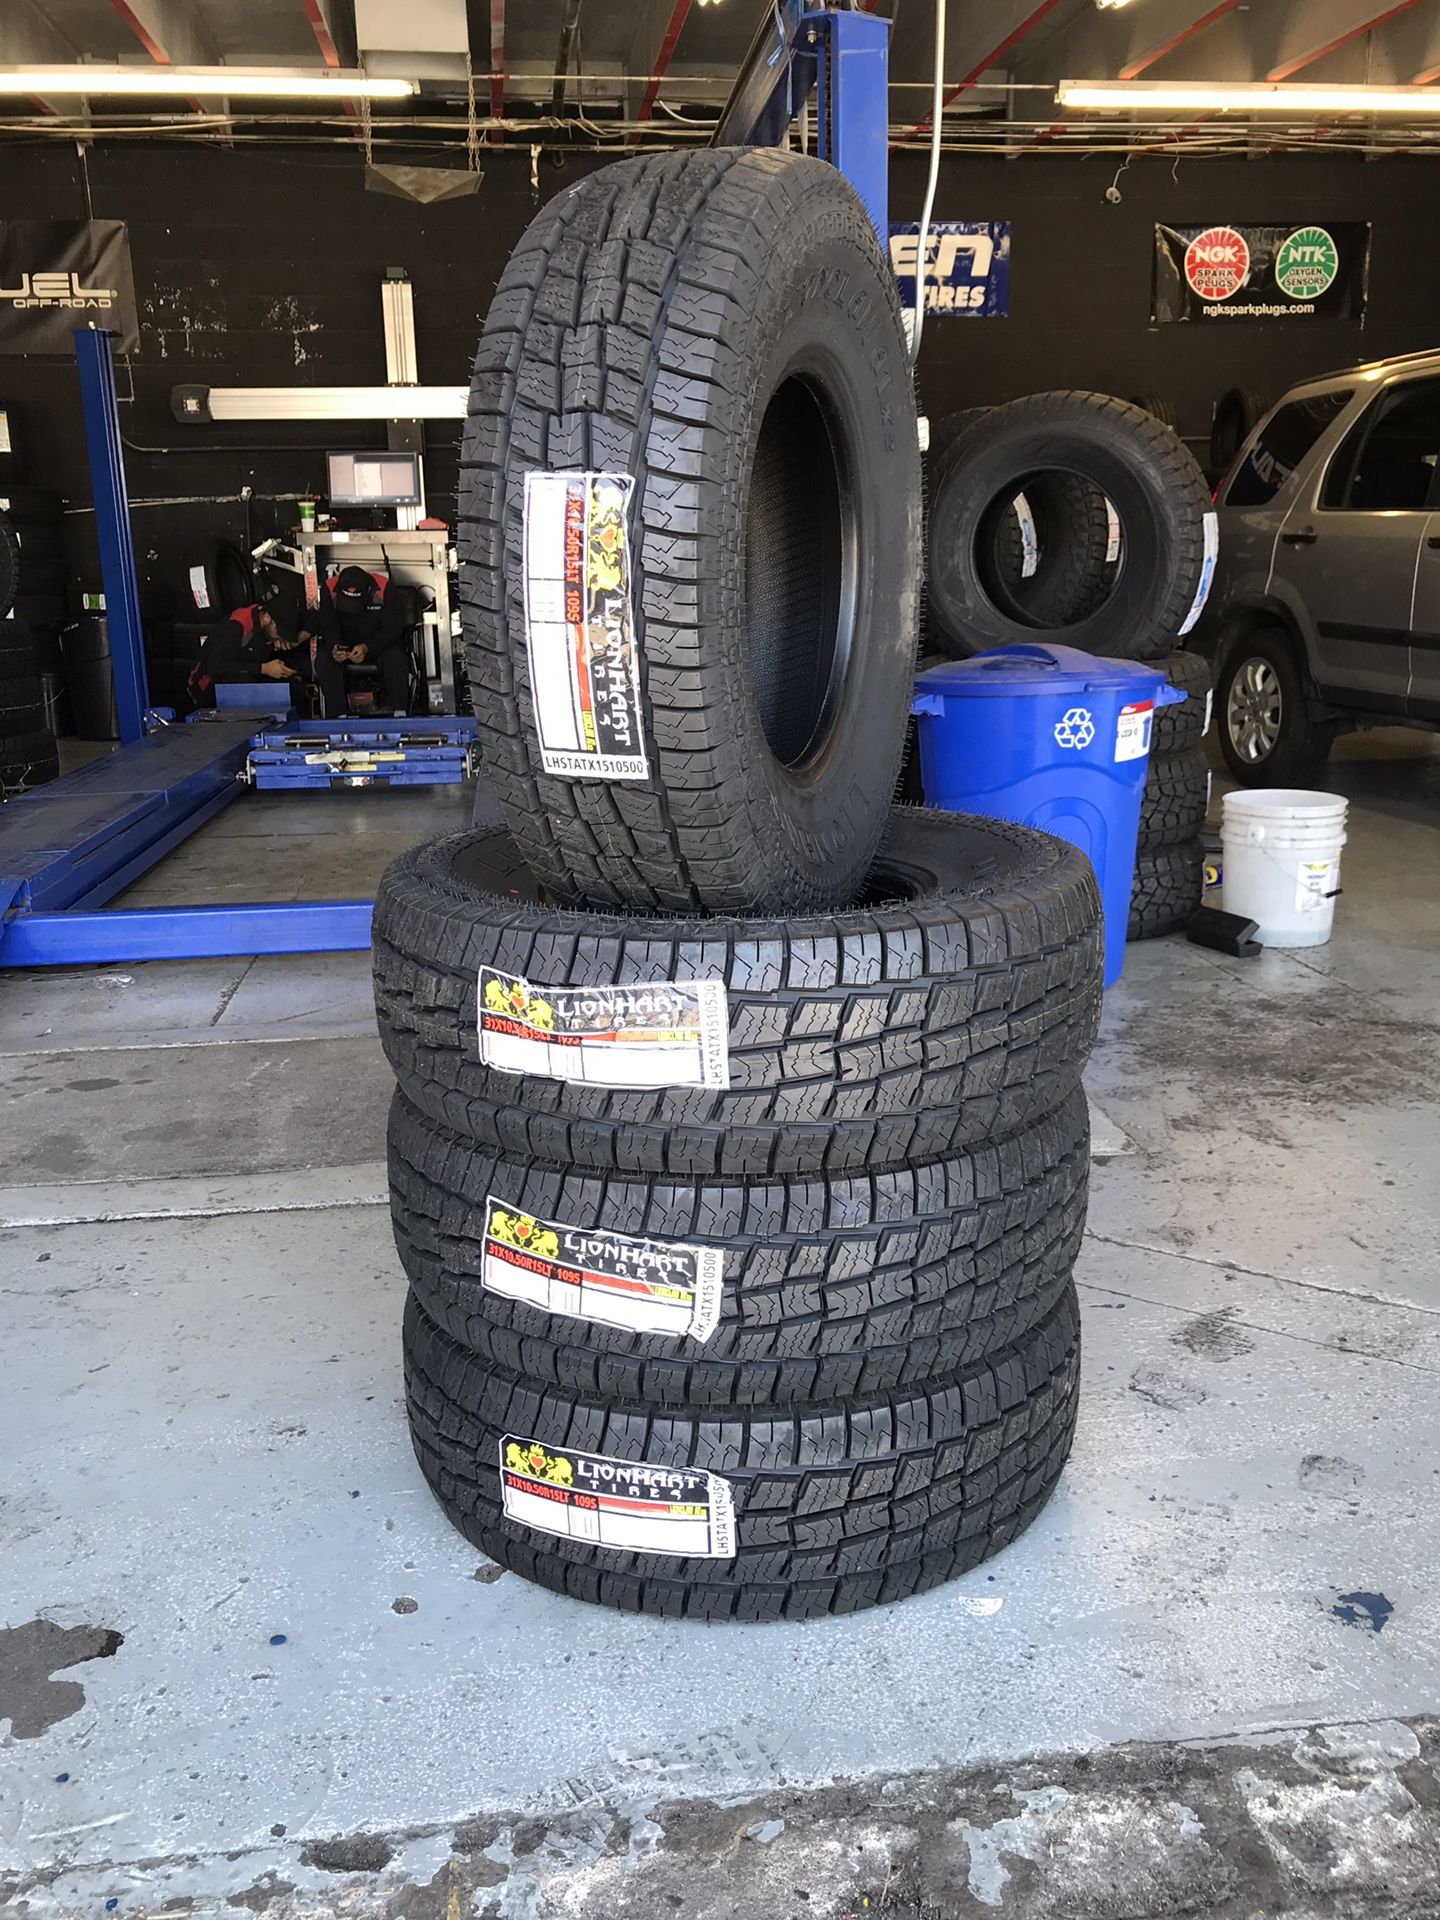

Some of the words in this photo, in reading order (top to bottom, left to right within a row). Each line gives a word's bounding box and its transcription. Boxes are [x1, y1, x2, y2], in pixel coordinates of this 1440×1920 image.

[1195, 246, 1239, 263] NGK
[1288, 246, 1327, 263] NTK
[1197, 269, 1235, 277] SPARK
[1289, 267, 1323, 276] OXYGEN
[1197, 279, 1234, 288] PLUGS
[1286, 277, 1325, 286] SENSORS
[13, 298, 112, 308] OFF-ROAD
[924, 285, 987, 308] IRES
[1203, 303, 1315, 317] ngksparkplugs.com
[566, 590, 581, 623] 109S
[604, 597, 631, 746] LIONHART
[546, 756, 644, 774] LHSTATX1510500
[557, 995, 688, 1018] LIONHART
[564, 1234, 689, 1273] LIONHART
[488, 1243, 551, 1277] 31X10.50R15LT
[557, 1269, 580, 1285] 109S
[577, 1460, 700, 1489] LIONHART
[507, 1475, 569, 1503] 31X10.50R15LT
[573, 1494, 597, 1509] 109S
[590, 1481, 681, 1500] TIRES
